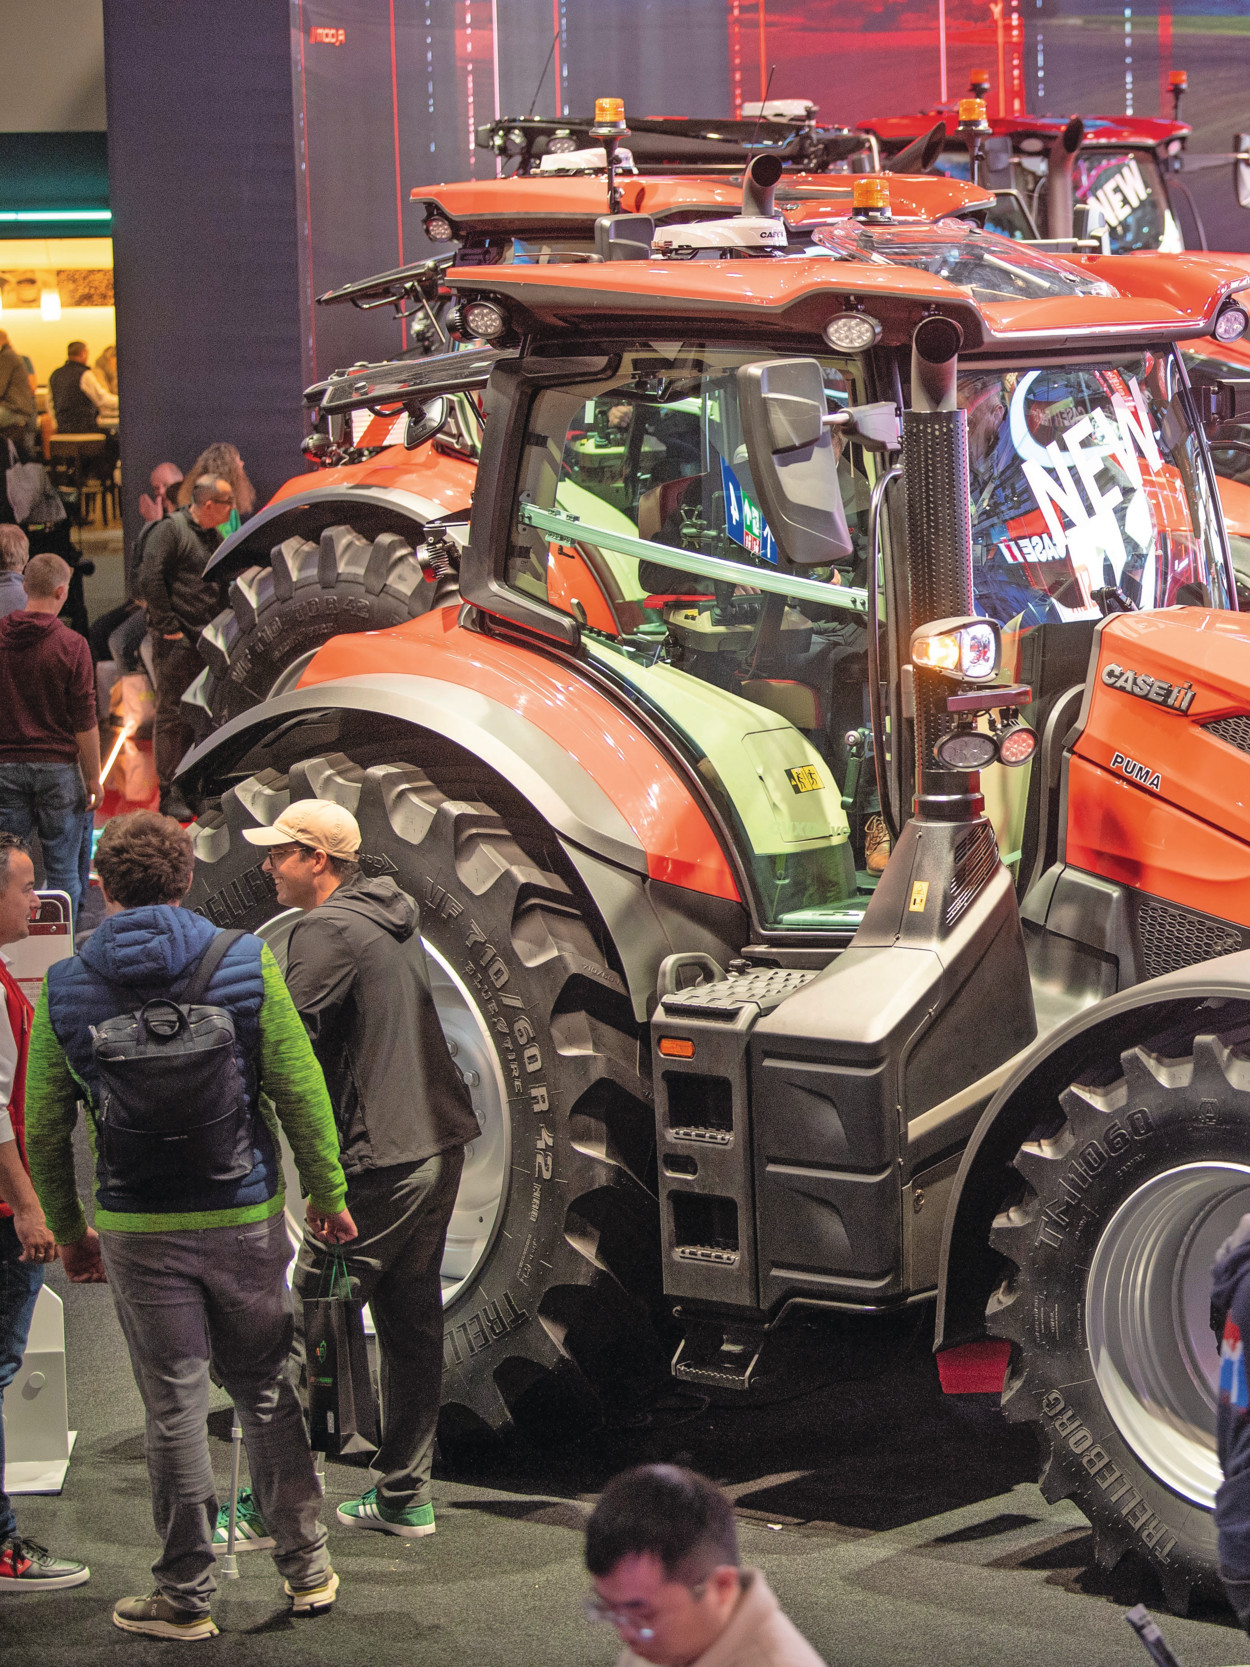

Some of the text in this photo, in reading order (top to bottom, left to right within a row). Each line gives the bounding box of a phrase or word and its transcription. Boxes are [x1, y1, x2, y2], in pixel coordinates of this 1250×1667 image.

[1086, 159, 1148, 228] NEW
[1021, 376, 1163, 547] NEW
[1102, 663, 1172, 703] CASE
[1110, 752, 1163, 792] PUMA
[425, 876, 465, 919] VF
[465, 918, 543, 1074] 710/60
[528, 1083, 550, 1113] R
[534, 1123, 554, 1181] 42
[1035, 1107, 1153, 1249] TM1060
[1042, 1389, 1179, 1565] TRELLEBORG
